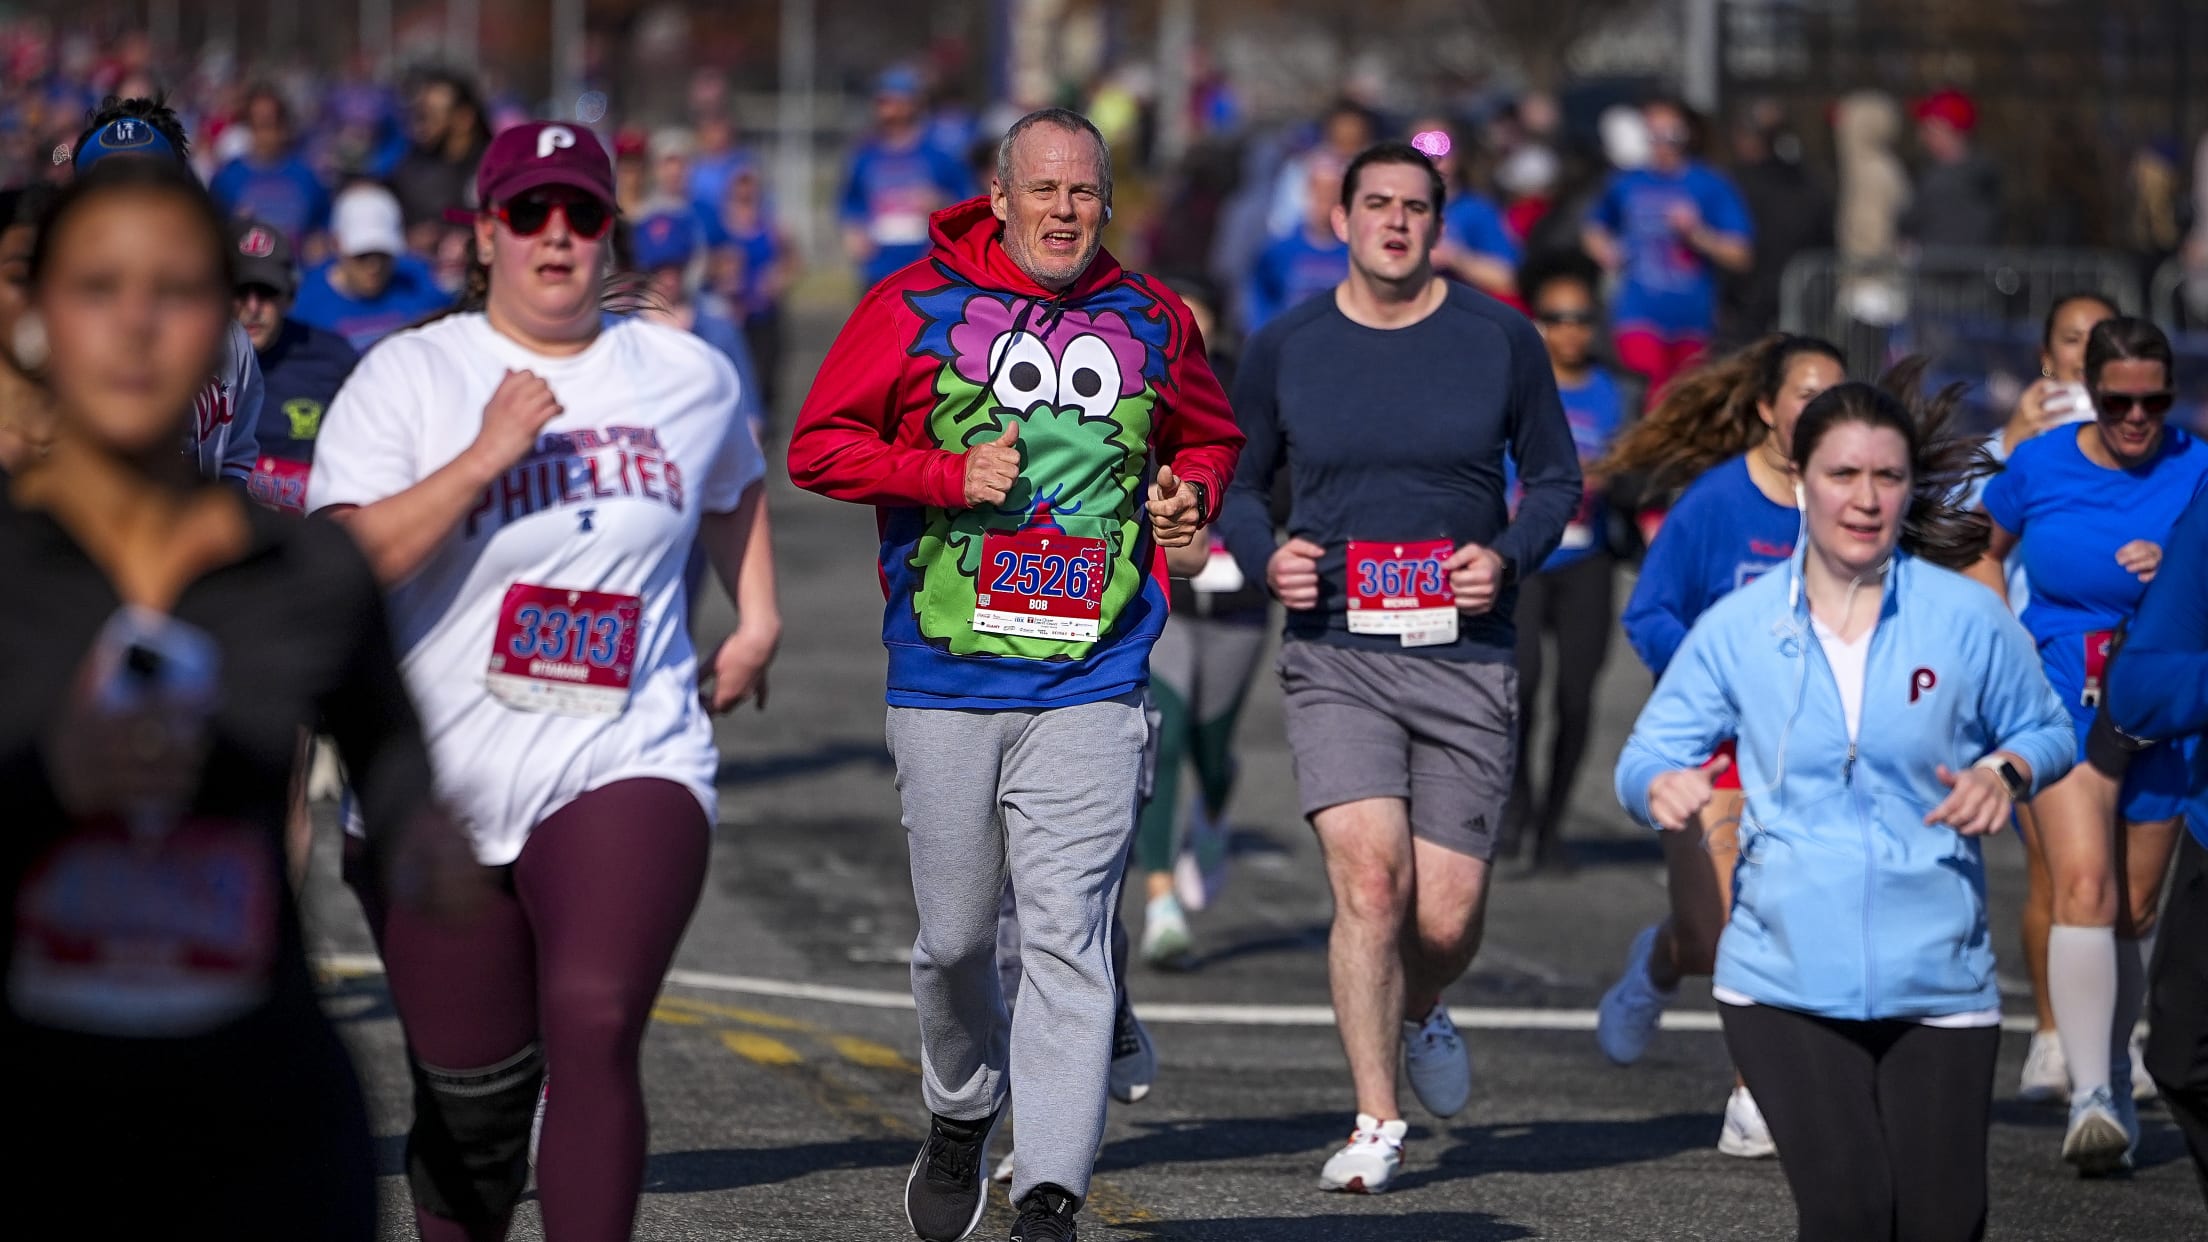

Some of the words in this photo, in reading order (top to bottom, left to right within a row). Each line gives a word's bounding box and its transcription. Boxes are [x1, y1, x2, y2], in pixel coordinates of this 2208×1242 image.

[537, 126, 576, 158] P
[466, 450, 684, 538] PHILLIES
[991, 551, 1089, 599] 2526
[1358, 559, 1441, 597] 3673
[1029, 599, 1048, 610] BOB
[509, 602, 624, 669] 3313
[1908, 665, 1937, 704] P
